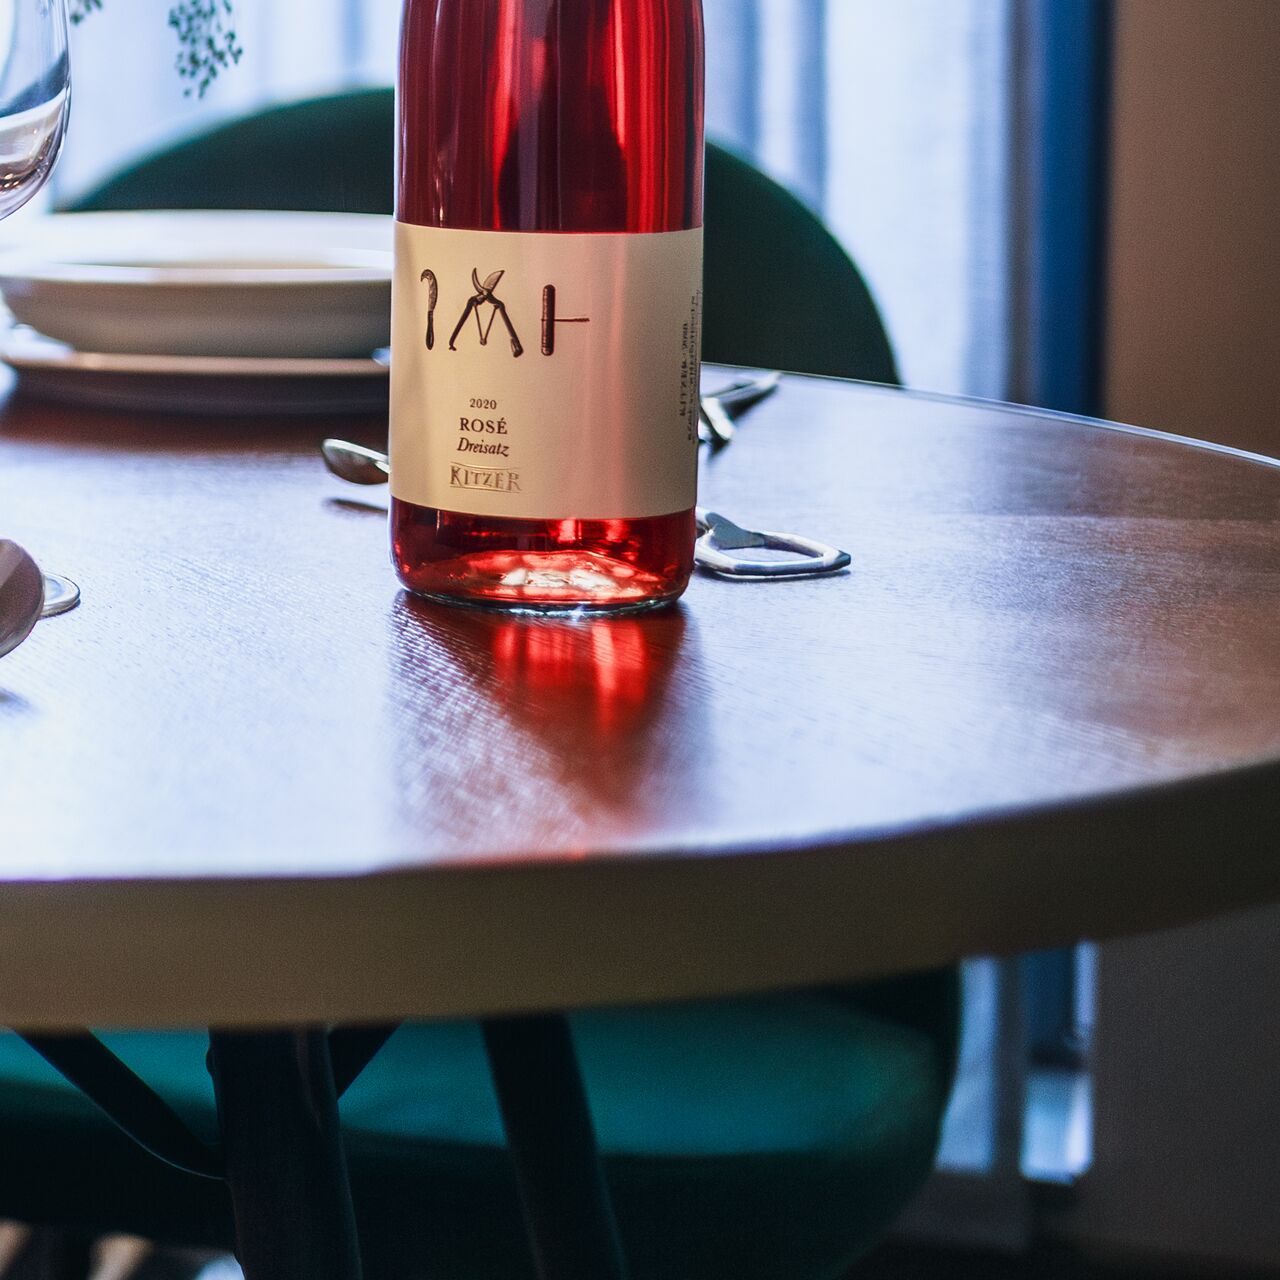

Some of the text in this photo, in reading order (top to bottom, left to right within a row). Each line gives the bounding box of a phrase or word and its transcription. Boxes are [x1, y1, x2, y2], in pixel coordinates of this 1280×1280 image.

[469, 398, 497, 410] 2020
[459, 417, 508, 435] ROSÉ
[456, 437, 510, 458] Dreisatz
[450, 465, 522, 491] KITZER
